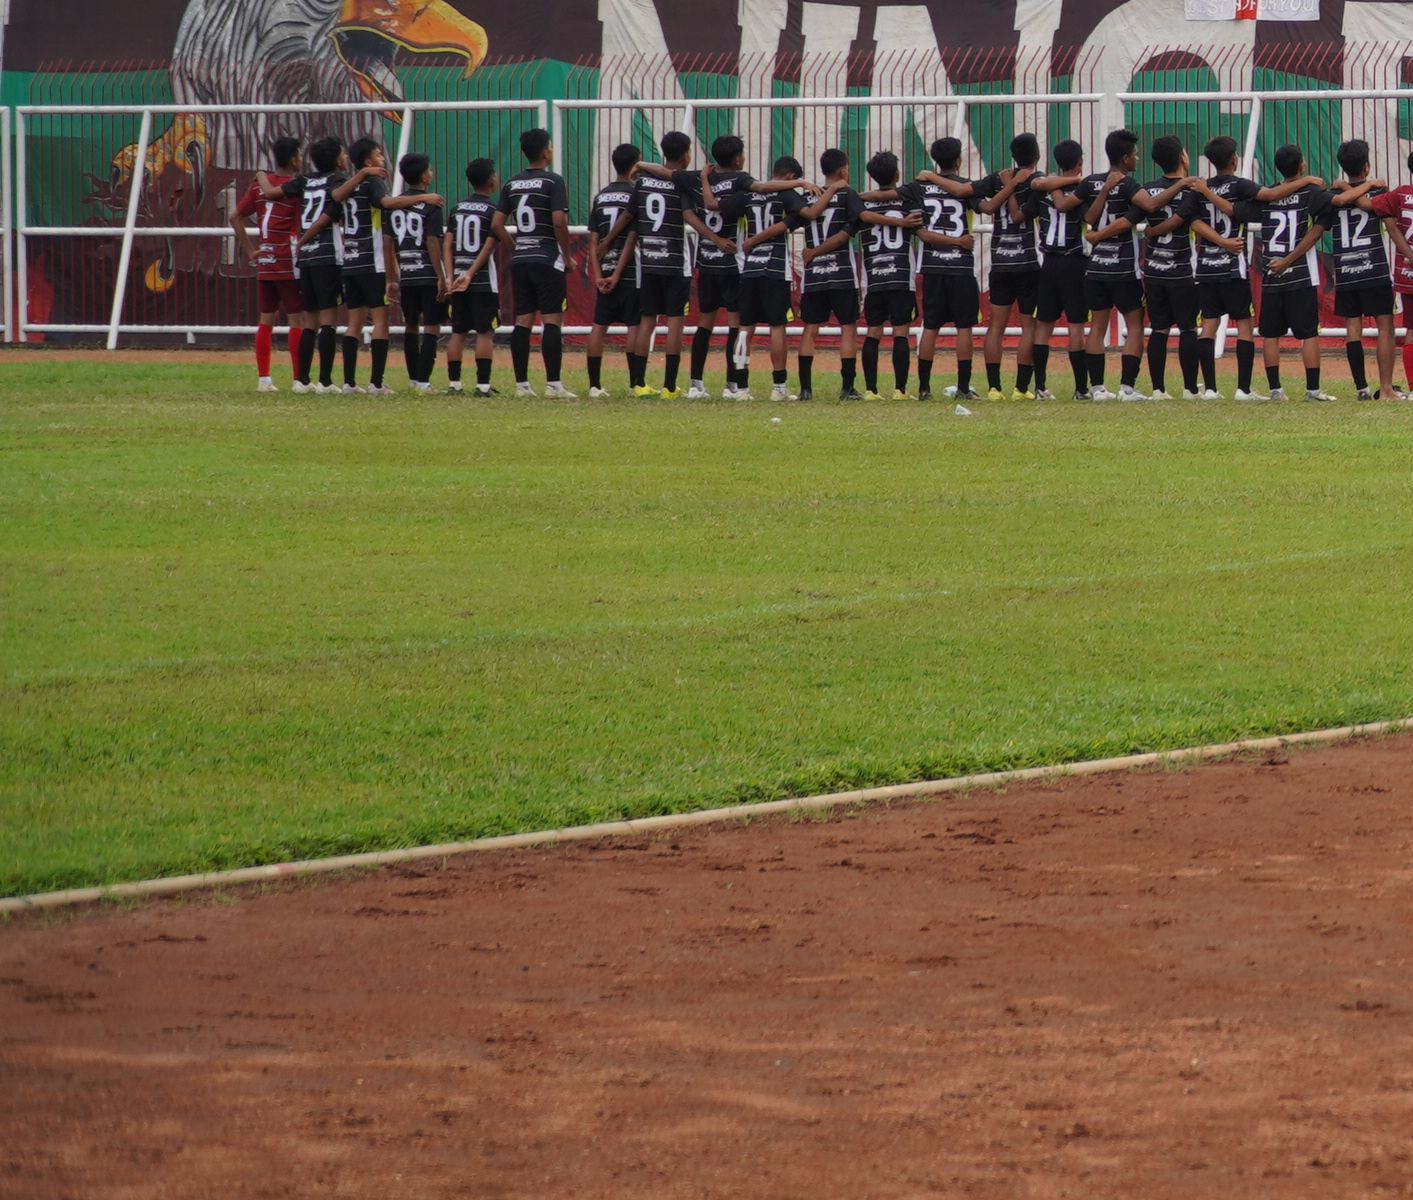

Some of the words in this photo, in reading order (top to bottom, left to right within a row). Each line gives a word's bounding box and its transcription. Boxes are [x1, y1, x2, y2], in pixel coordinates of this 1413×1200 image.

[390, 209, 424, 247] 99
[516, 194, 537, 233] 6
[602, 206, 620, 235] 7
[645, 192, 667, 233] 9
[923, 199, 965, 238] 23
[1268, 209, 1298, 253] 21
[1337, 207, 1372, 249] 12
[455, 214, 481, 253] 10
